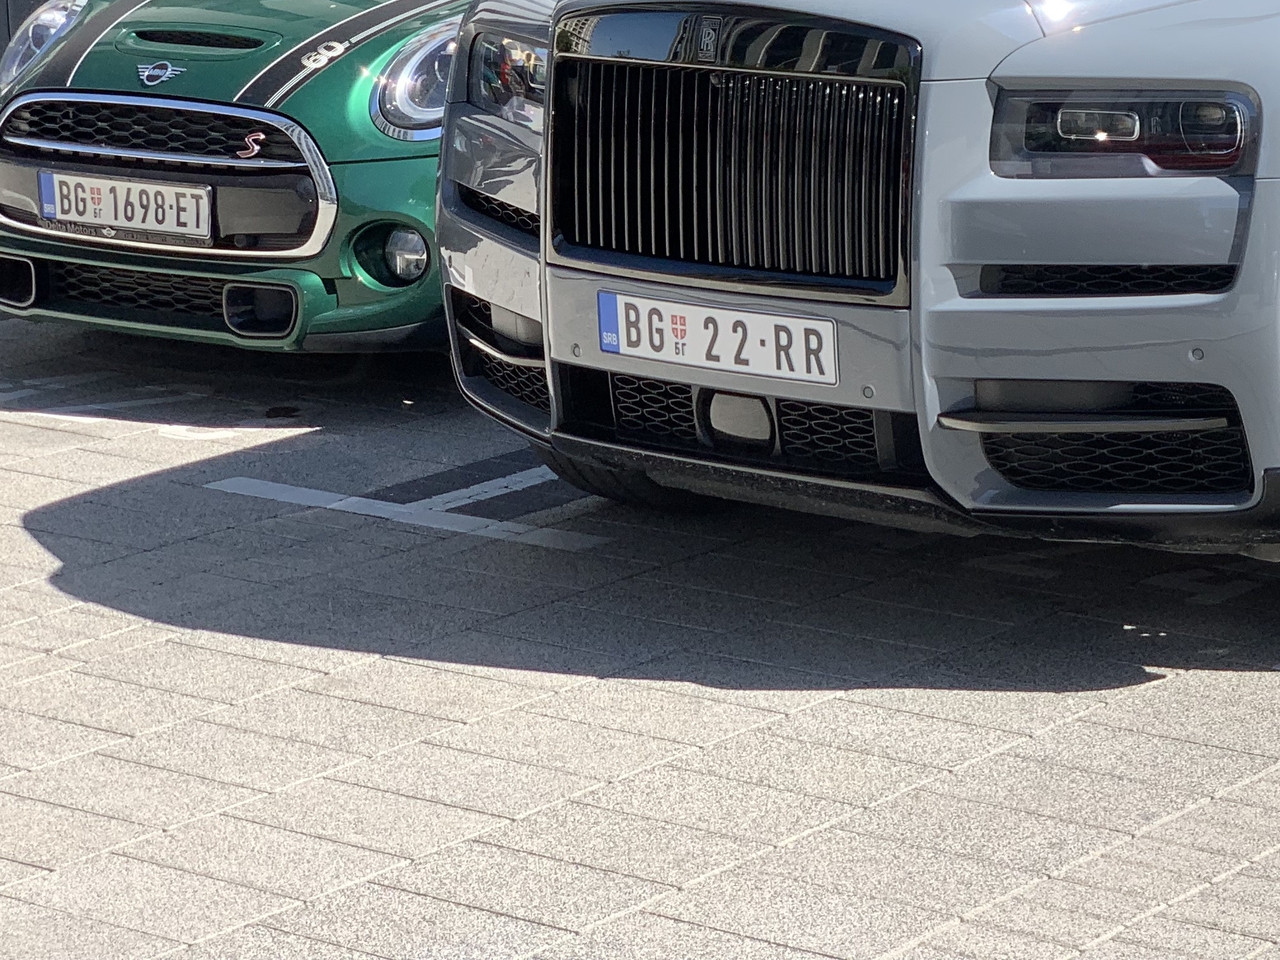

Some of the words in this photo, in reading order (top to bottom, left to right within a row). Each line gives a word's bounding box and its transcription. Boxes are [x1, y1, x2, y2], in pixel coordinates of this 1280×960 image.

[301, 41, 345, 68] 60
[236, 132, 266, 158] S
[44, 204, 55, 213] SRB
[58, 180, 87, 217] BG
[45, 221, 67, 232] Delta
[67, 223, 97, 236] Motors
[602, 331, 618, 346] SRB
[623, 302, 665, 353] BG
